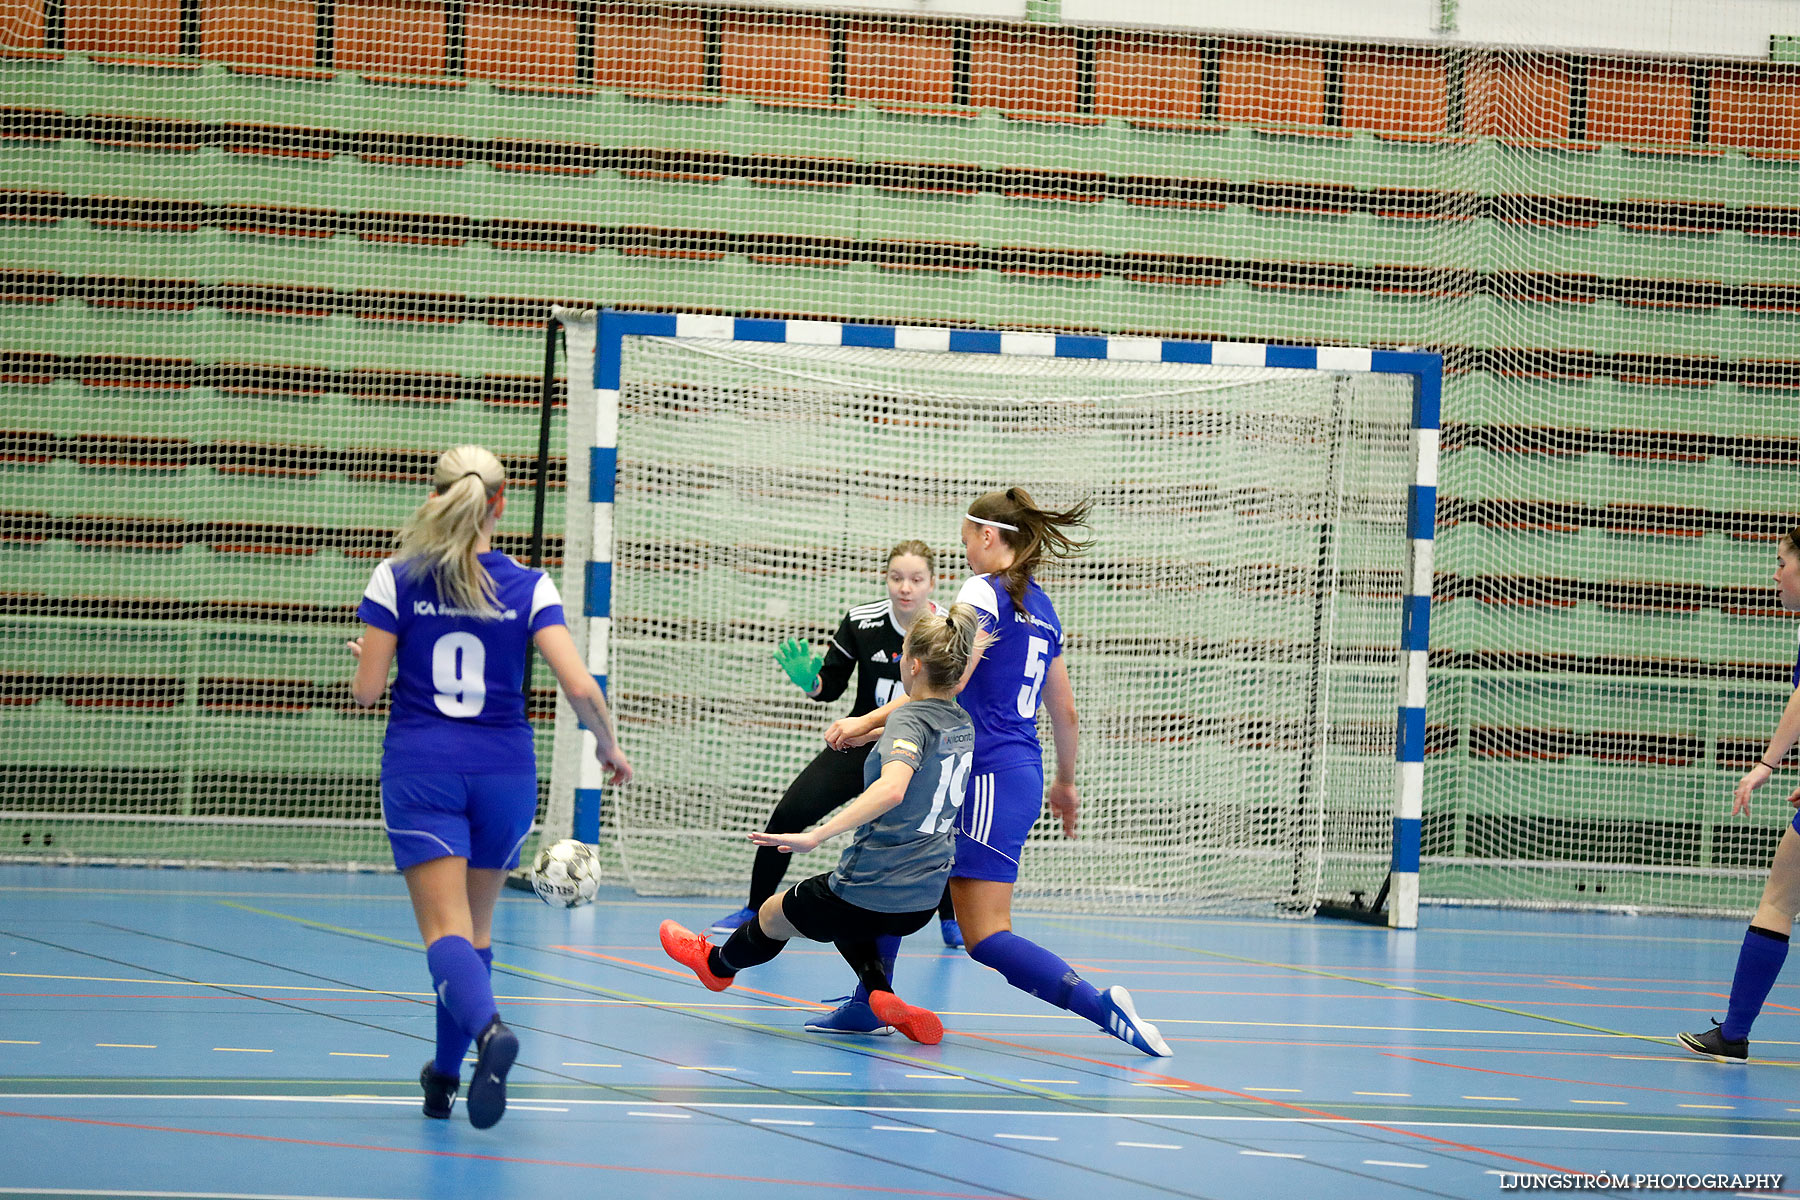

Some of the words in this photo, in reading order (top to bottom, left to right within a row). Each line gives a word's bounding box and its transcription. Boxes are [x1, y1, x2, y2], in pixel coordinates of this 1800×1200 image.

[413, 600, 436, 616] ICA
[432, 631, 486, 718] 9
[1017, 635, 1049, 719] 5
[916, 752, 973, 834] 19
